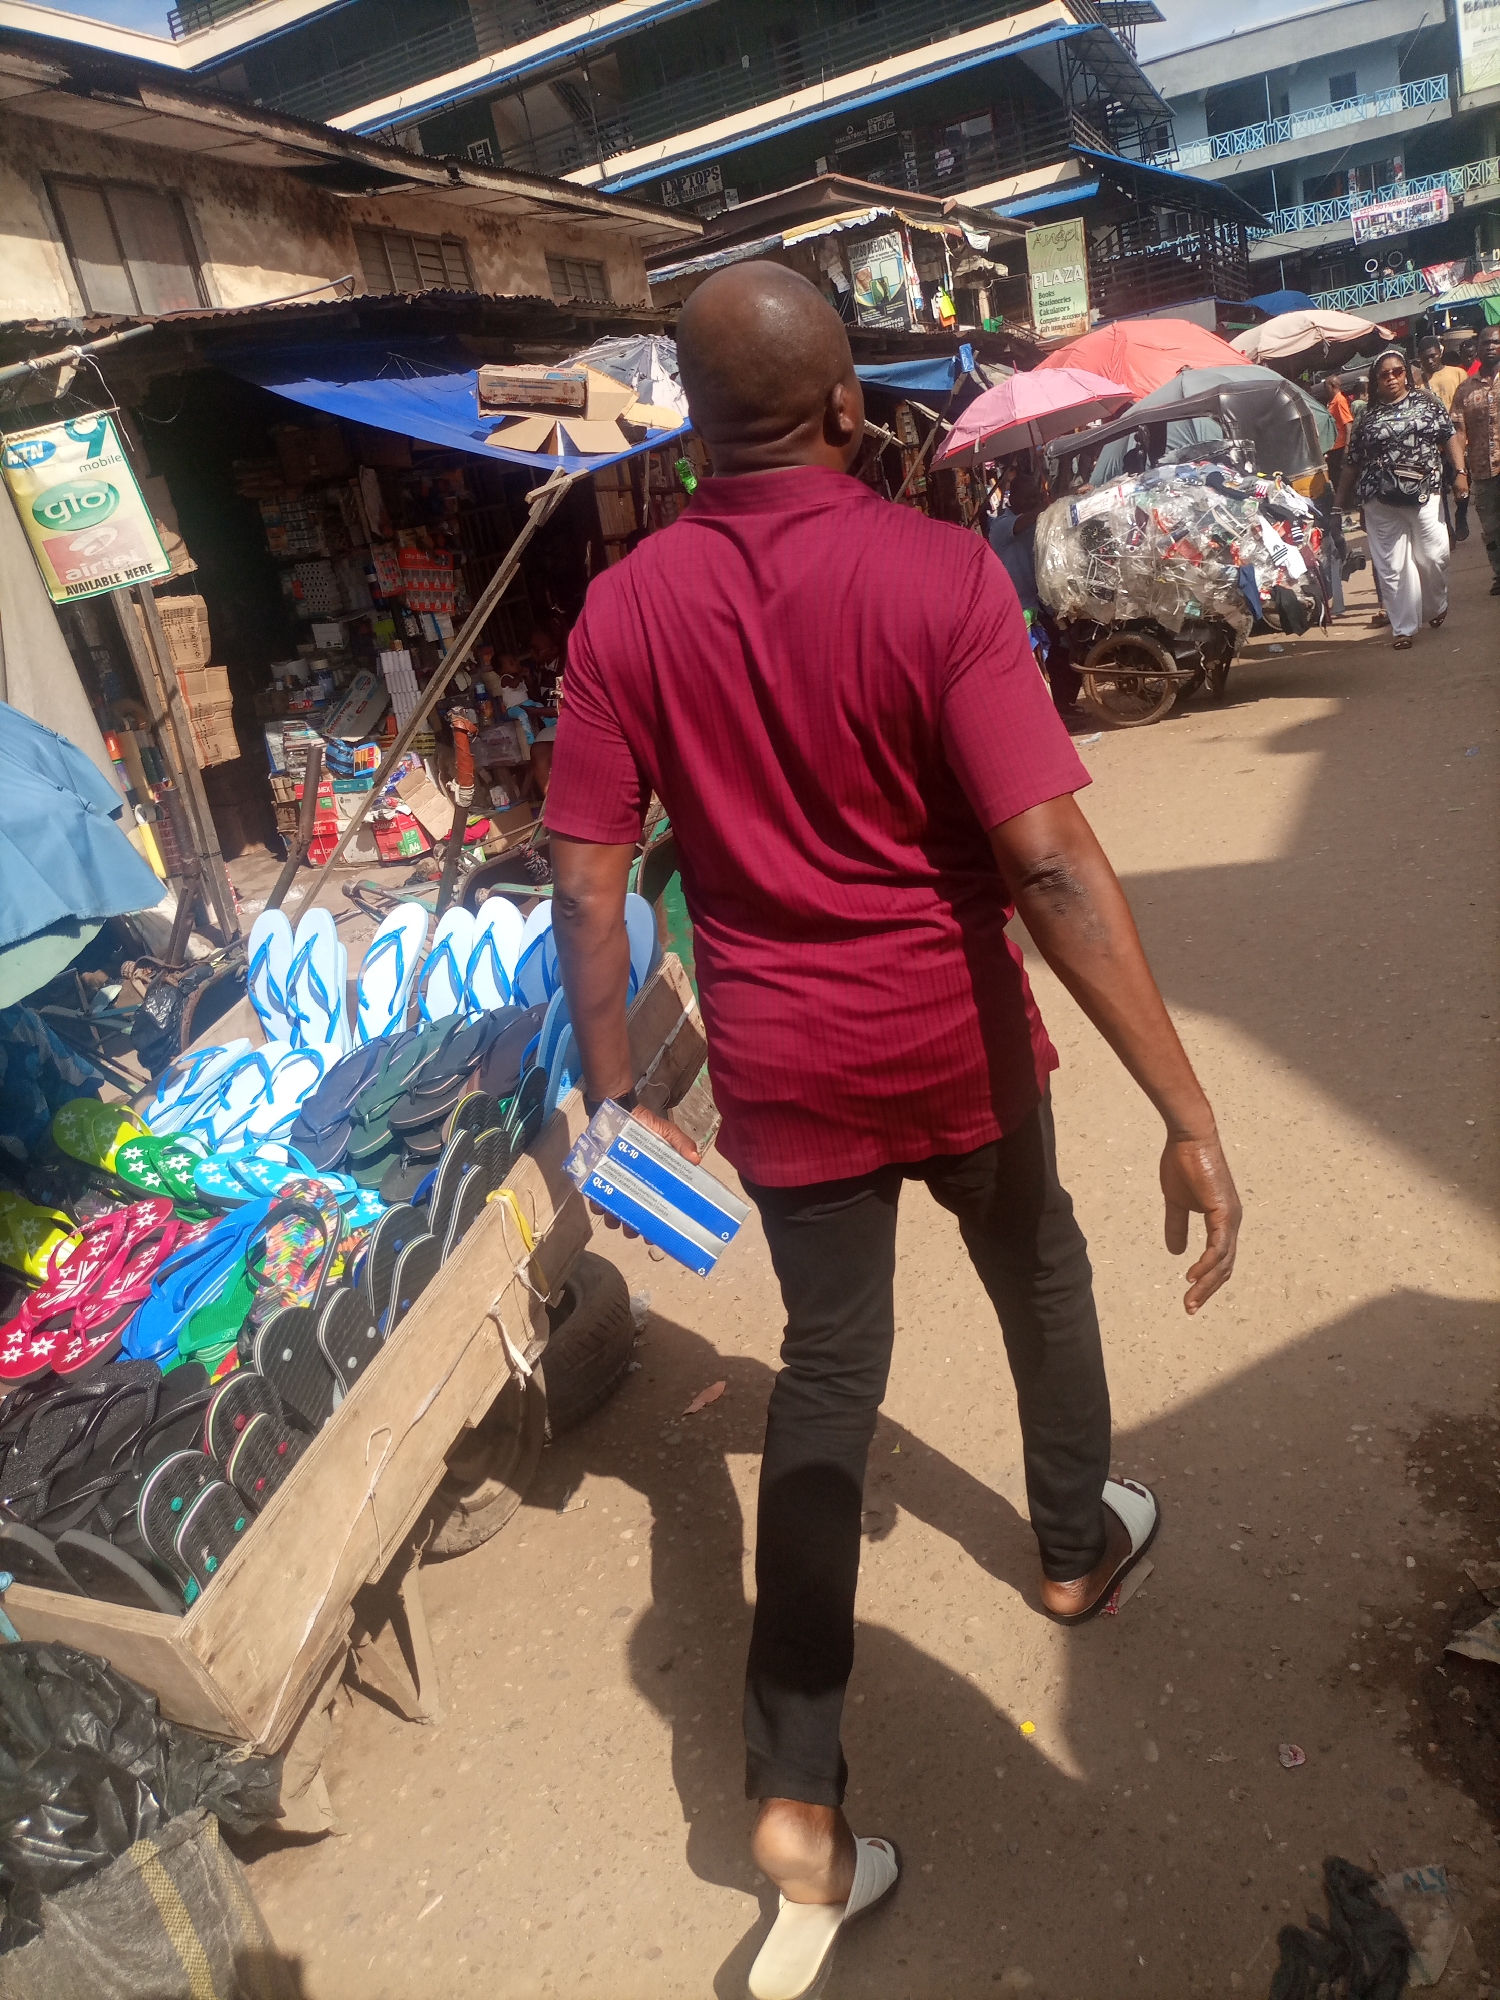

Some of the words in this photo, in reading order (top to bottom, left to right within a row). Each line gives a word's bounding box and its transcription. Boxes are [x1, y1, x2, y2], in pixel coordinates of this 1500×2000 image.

[1407, 191, 1432, 203] GADGET
[1032, 264, 1084, 289] PLAZA
[1038, 296, 1072, 307] Stationeries
[1039, 290, 1055, 299] Books
[1039, 305, 1071, 317] Calculators
[1039, 315, 1061, 325] Computer
[1040, 325, 1051, 334] Gift
[7, 443, 44, 466] MTN
[79, 454, 122, 473] mobile
[44, 489, 107, 525] glo
[66, 548, 144, 581] airtel
[66, 573, 121, 596] AVAILABLE
[126, 563, 155, 580] HERE
[409, 842, 420, 854] A4
[618, 1141, 639, 1159] QL-10
[592, 1176, 614, 1195] QL-10
